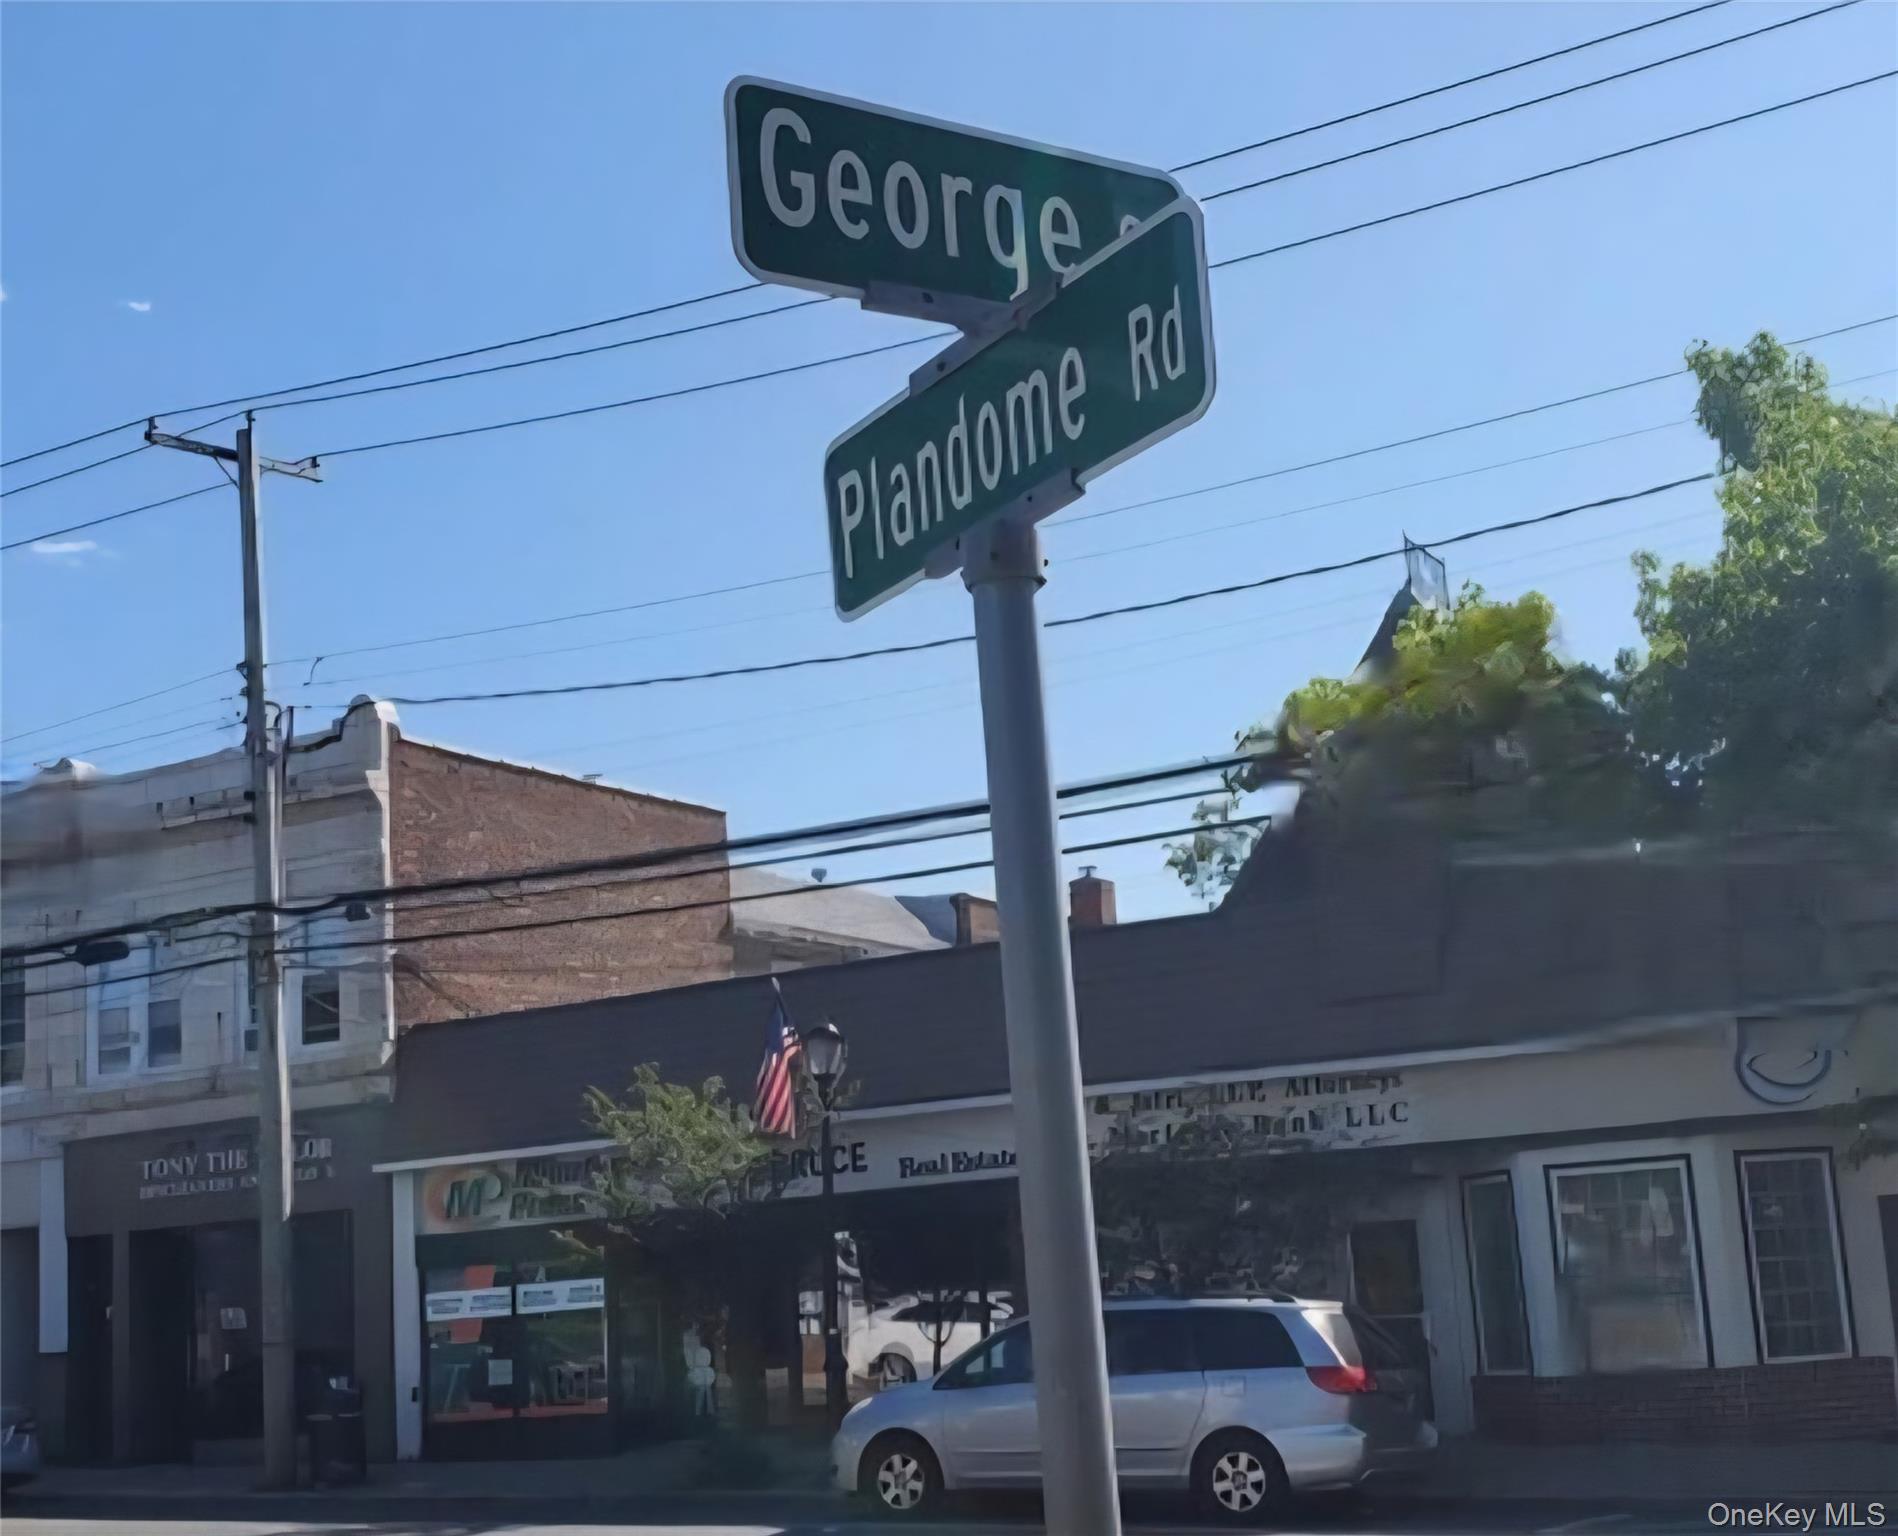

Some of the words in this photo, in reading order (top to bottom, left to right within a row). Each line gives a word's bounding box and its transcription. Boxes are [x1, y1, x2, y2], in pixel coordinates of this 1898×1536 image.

[759, 107, 1082, 301] George
[837, 346, 1087, 578] Plandome
[1127, 284, 1186, 401] Rd
[143, 1154, 198, 1180] TONY
[206, 1149, 249, 1172] THE
[1345, 1101, 1409, 1128] LLC
